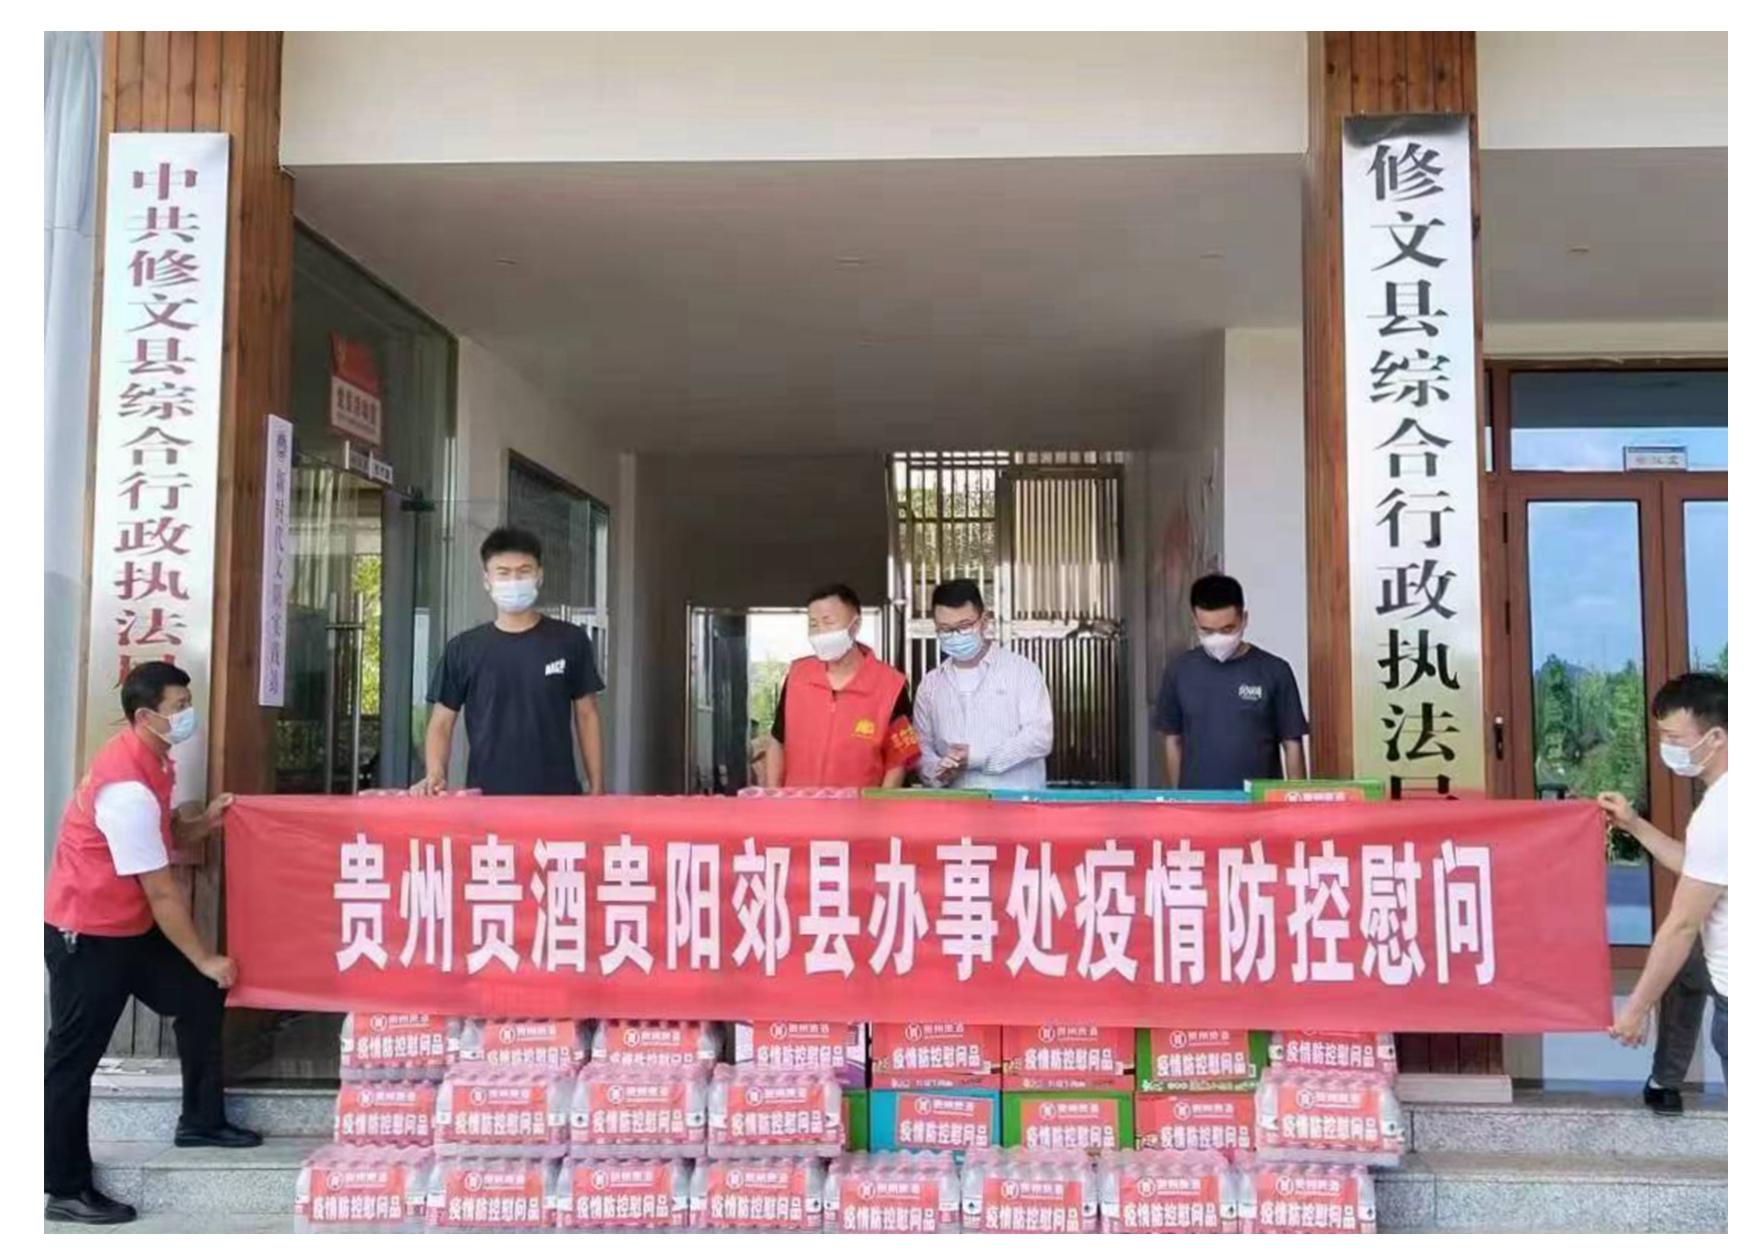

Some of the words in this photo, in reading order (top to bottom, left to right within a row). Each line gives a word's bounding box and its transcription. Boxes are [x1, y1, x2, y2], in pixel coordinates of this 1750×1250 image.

[332, 831, 1497, 987] 贵州贵酒贵阳郊县办事处疫情防控慰问
